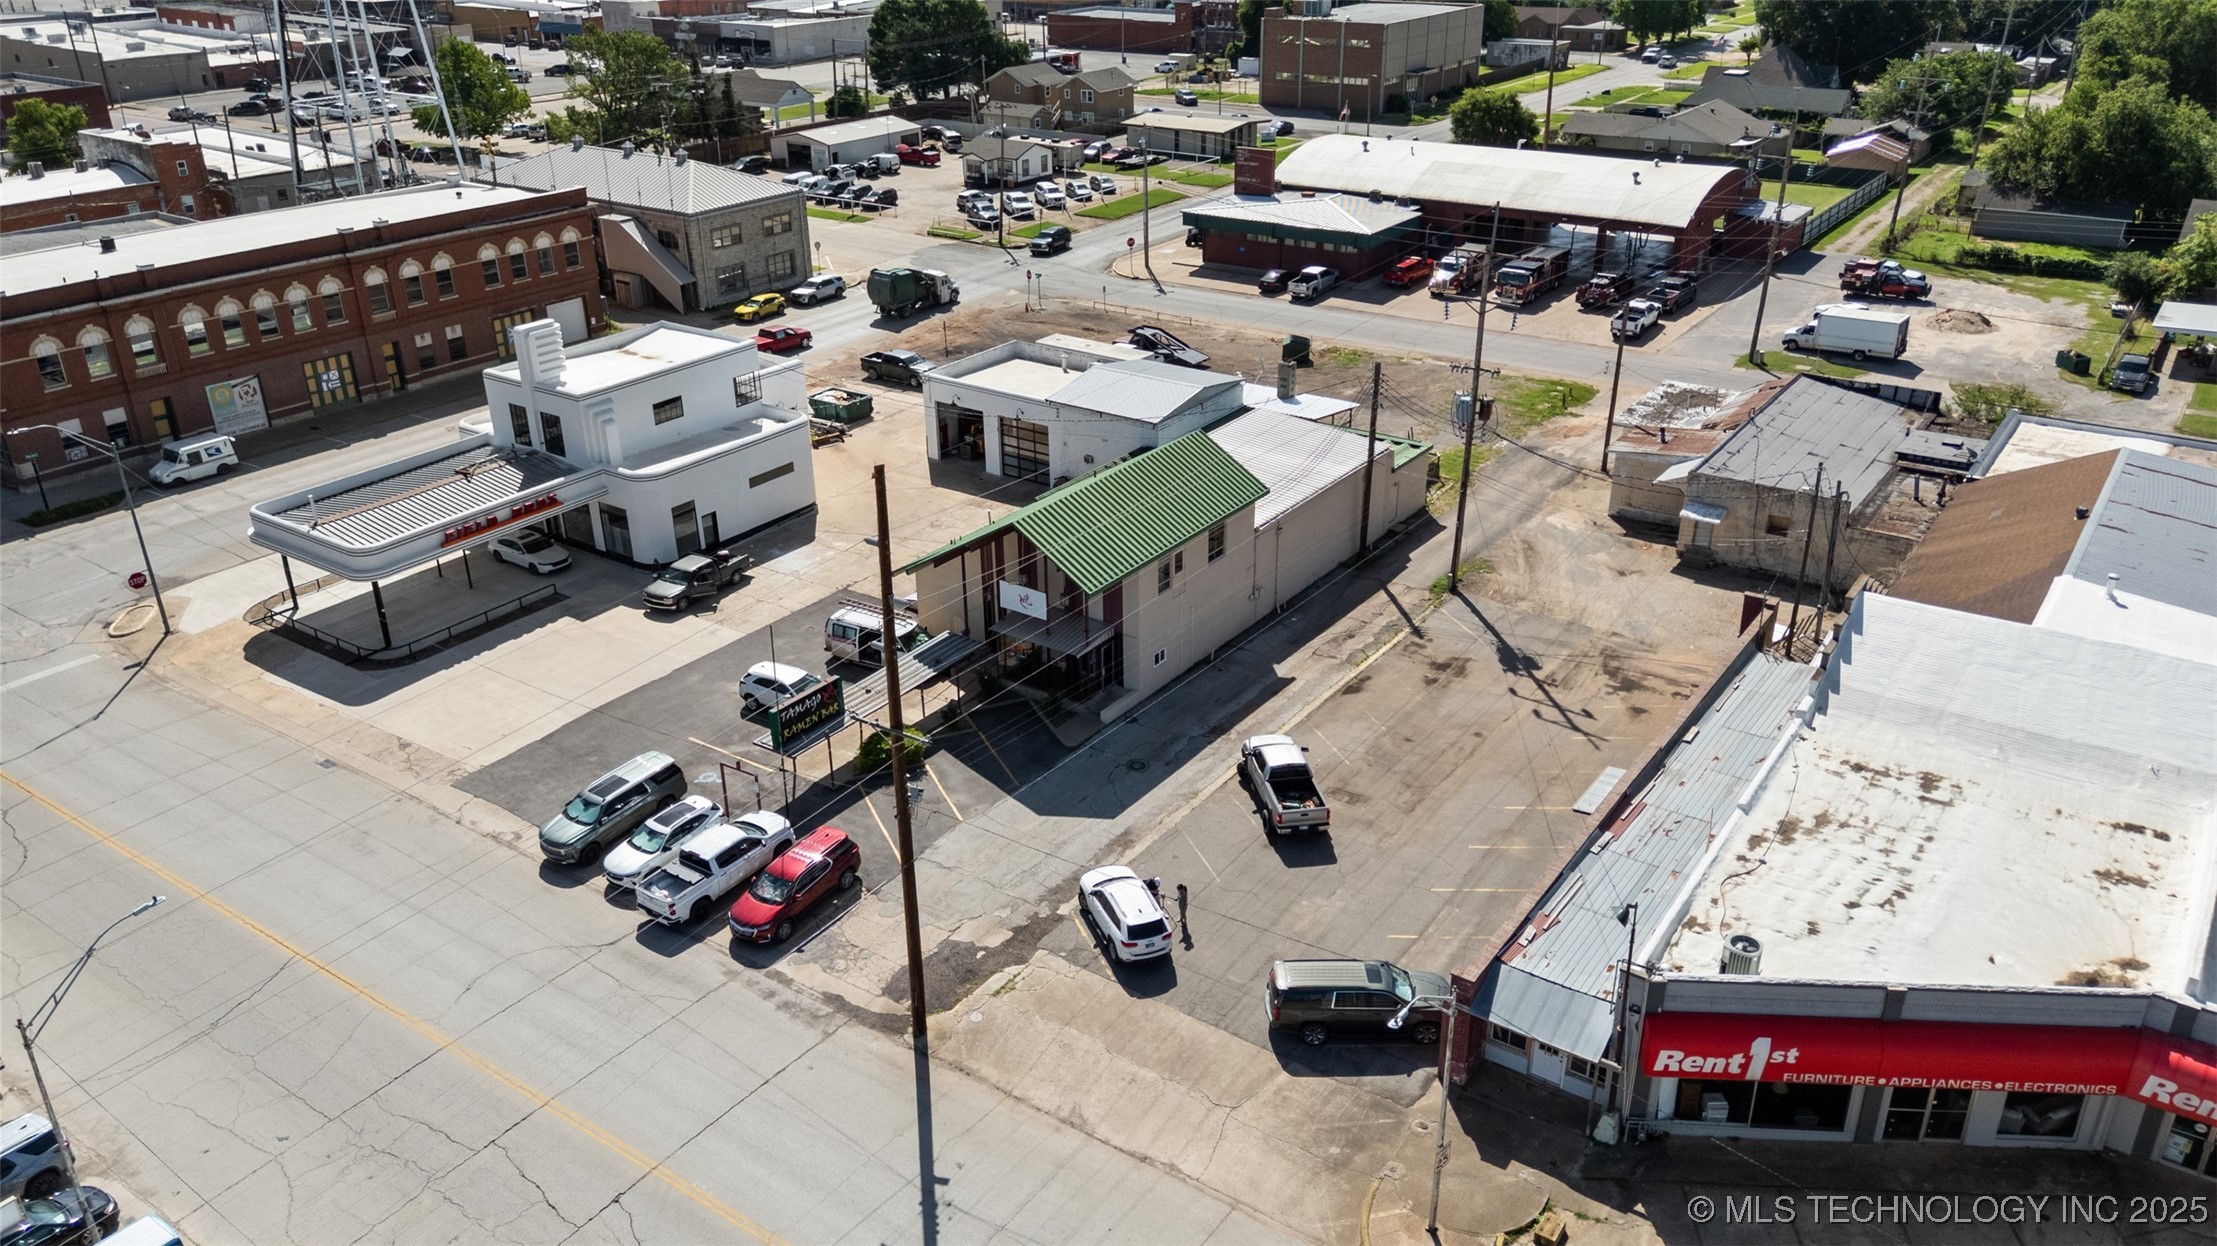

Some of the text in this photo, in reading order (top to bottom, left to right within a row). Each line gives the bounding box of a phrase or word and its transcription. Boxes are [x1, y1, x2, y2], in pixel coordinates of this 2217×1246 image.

[444, 492, 558, 541] FIELD BROS
[130, 575, 145, 586] STOP
[783, 703, 839, 741] RAMEN BAR
[1783, 1073, 2117, 1095] FURNITURE APPLIANCES ELECTRONICS
[1436, 1153, 1449, 1169] 25
